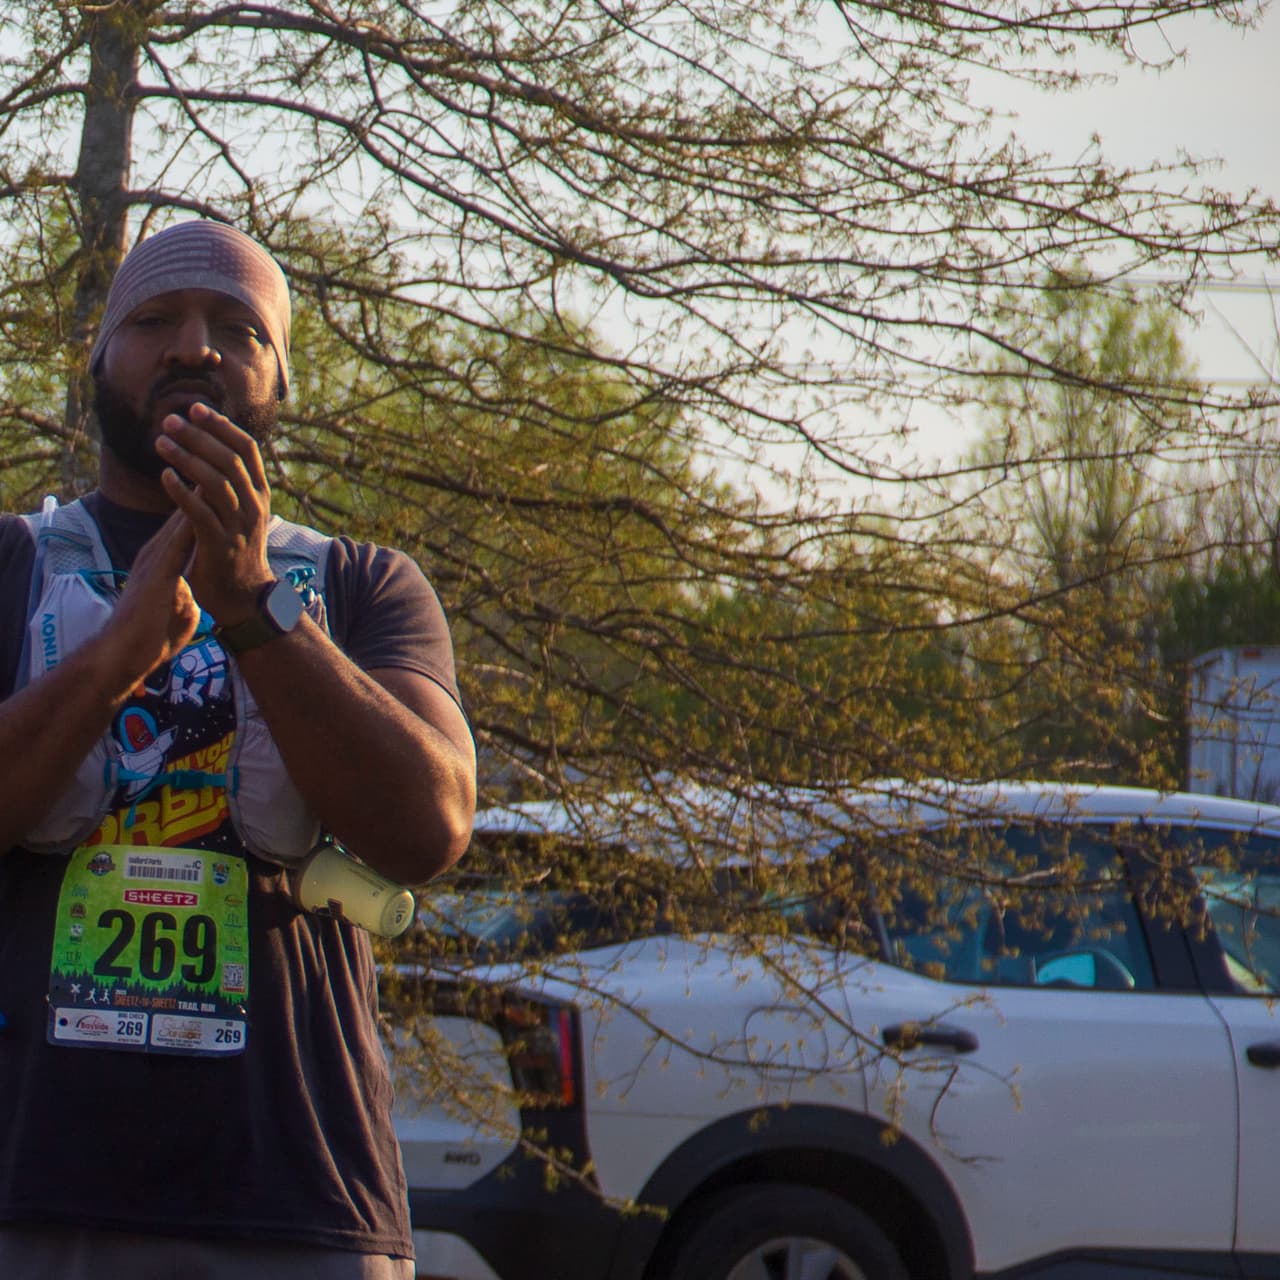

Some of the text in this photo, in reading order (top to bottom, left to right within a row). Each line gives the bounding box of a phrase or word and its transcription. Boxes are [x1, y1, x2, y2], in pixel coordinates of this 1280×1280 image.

[128, 891, 195, 904] SHEETZ
[93, 909, 217, 983] 269
[116, 1020, 143, 1036] 269
[215, 1028, 241, 1044] 269
